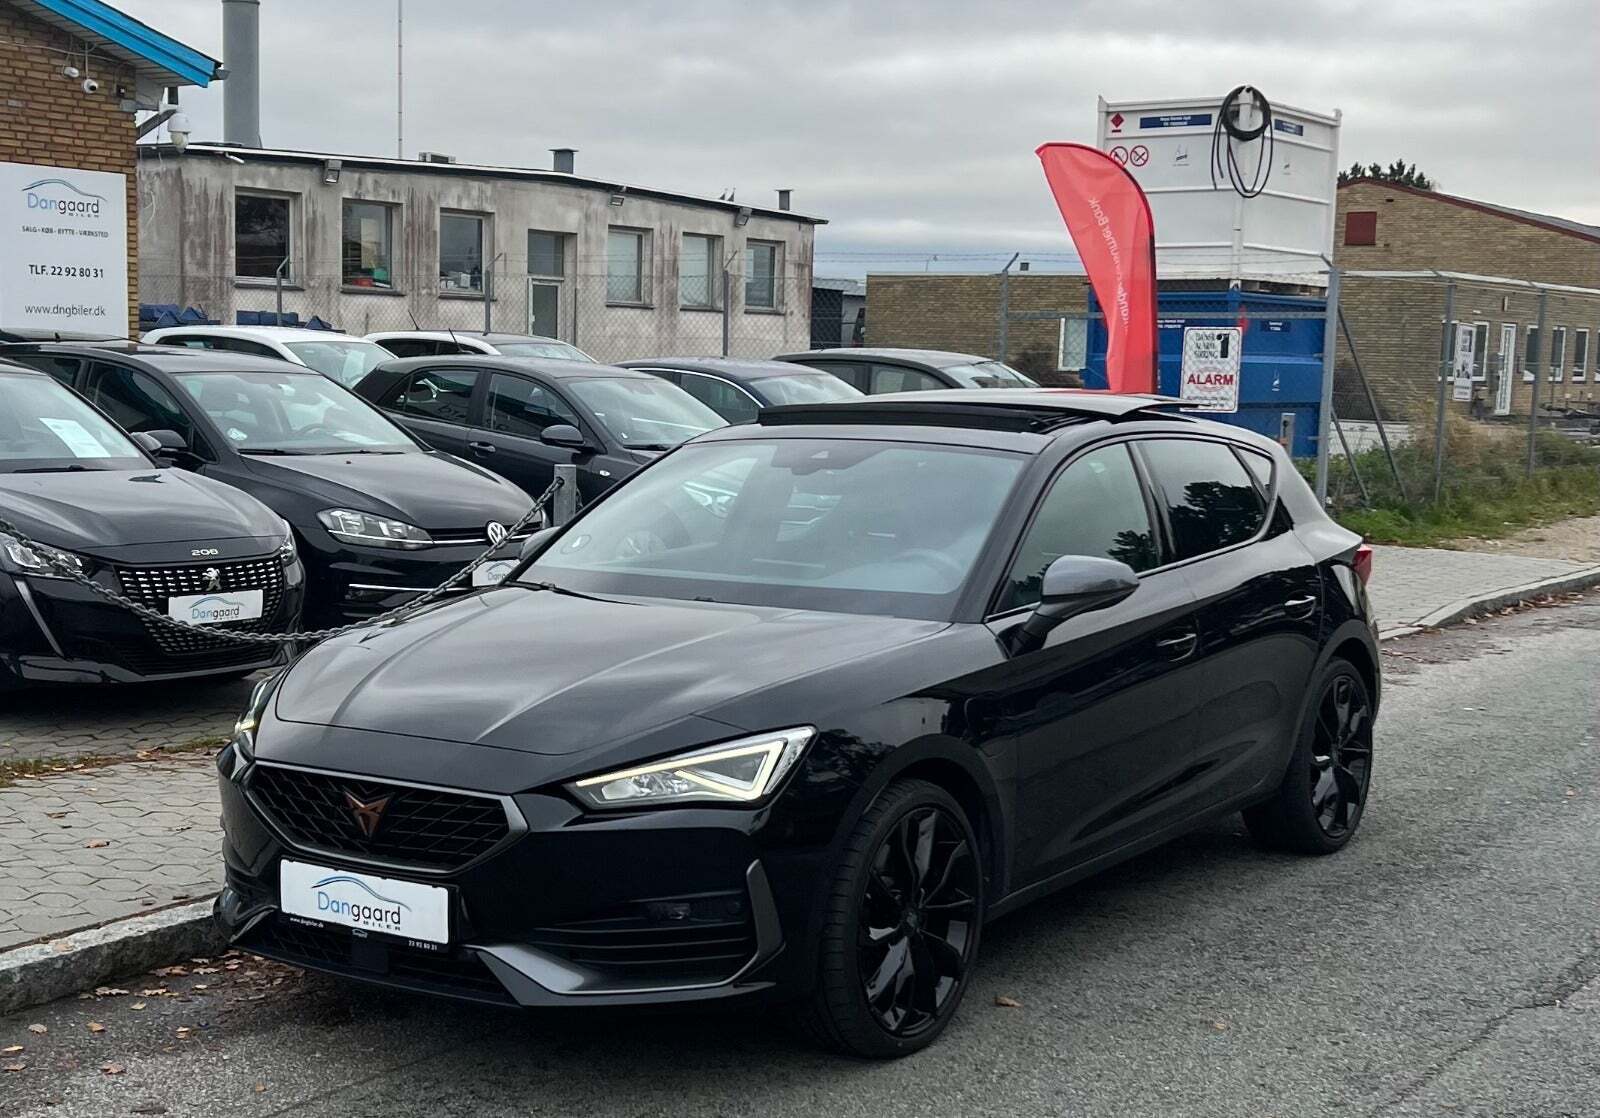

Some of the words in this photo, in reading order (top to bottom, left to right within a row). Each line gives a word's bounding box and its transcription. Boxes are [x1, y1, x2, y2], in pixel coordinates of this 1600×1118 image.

[27, 192, 100, 214] Dangaard
[28, 264, 48, 276] TLF.
[50, 265, 62, 276] 22
[65, 266, 77, 277] 92
[79, 267, 91, 278] 80
[93, 268, 104, 279] 31
[25, 304, 106, 318] www.dngbiler.dk
[1187, 373, 1234, 385] ALARM
[191, 548, 219, 556] 208
[192, 606, 240, 620] Dangaard
[317, 891, 401, 925] Dangaard
